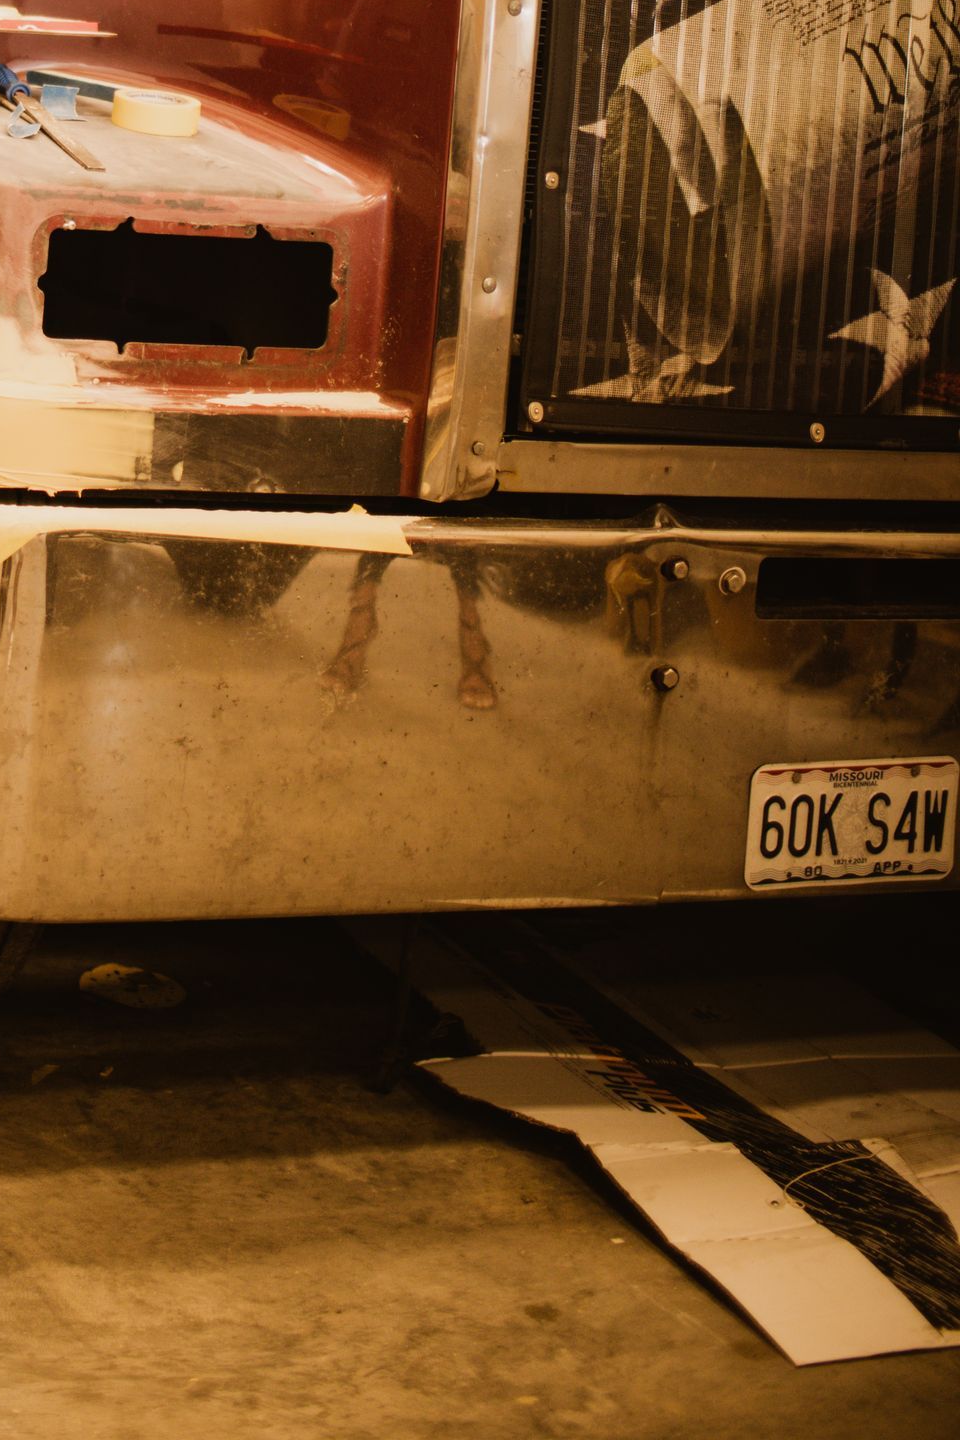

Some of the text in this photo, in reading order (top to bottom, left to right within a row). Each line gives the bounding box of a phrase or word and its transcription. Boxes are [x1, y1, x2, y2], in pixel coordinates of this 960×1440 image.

[829, 771, 884, 782] MISSOURI
[865, 789, 948, 855] S4W
[874, 861, 902, 873] APP
